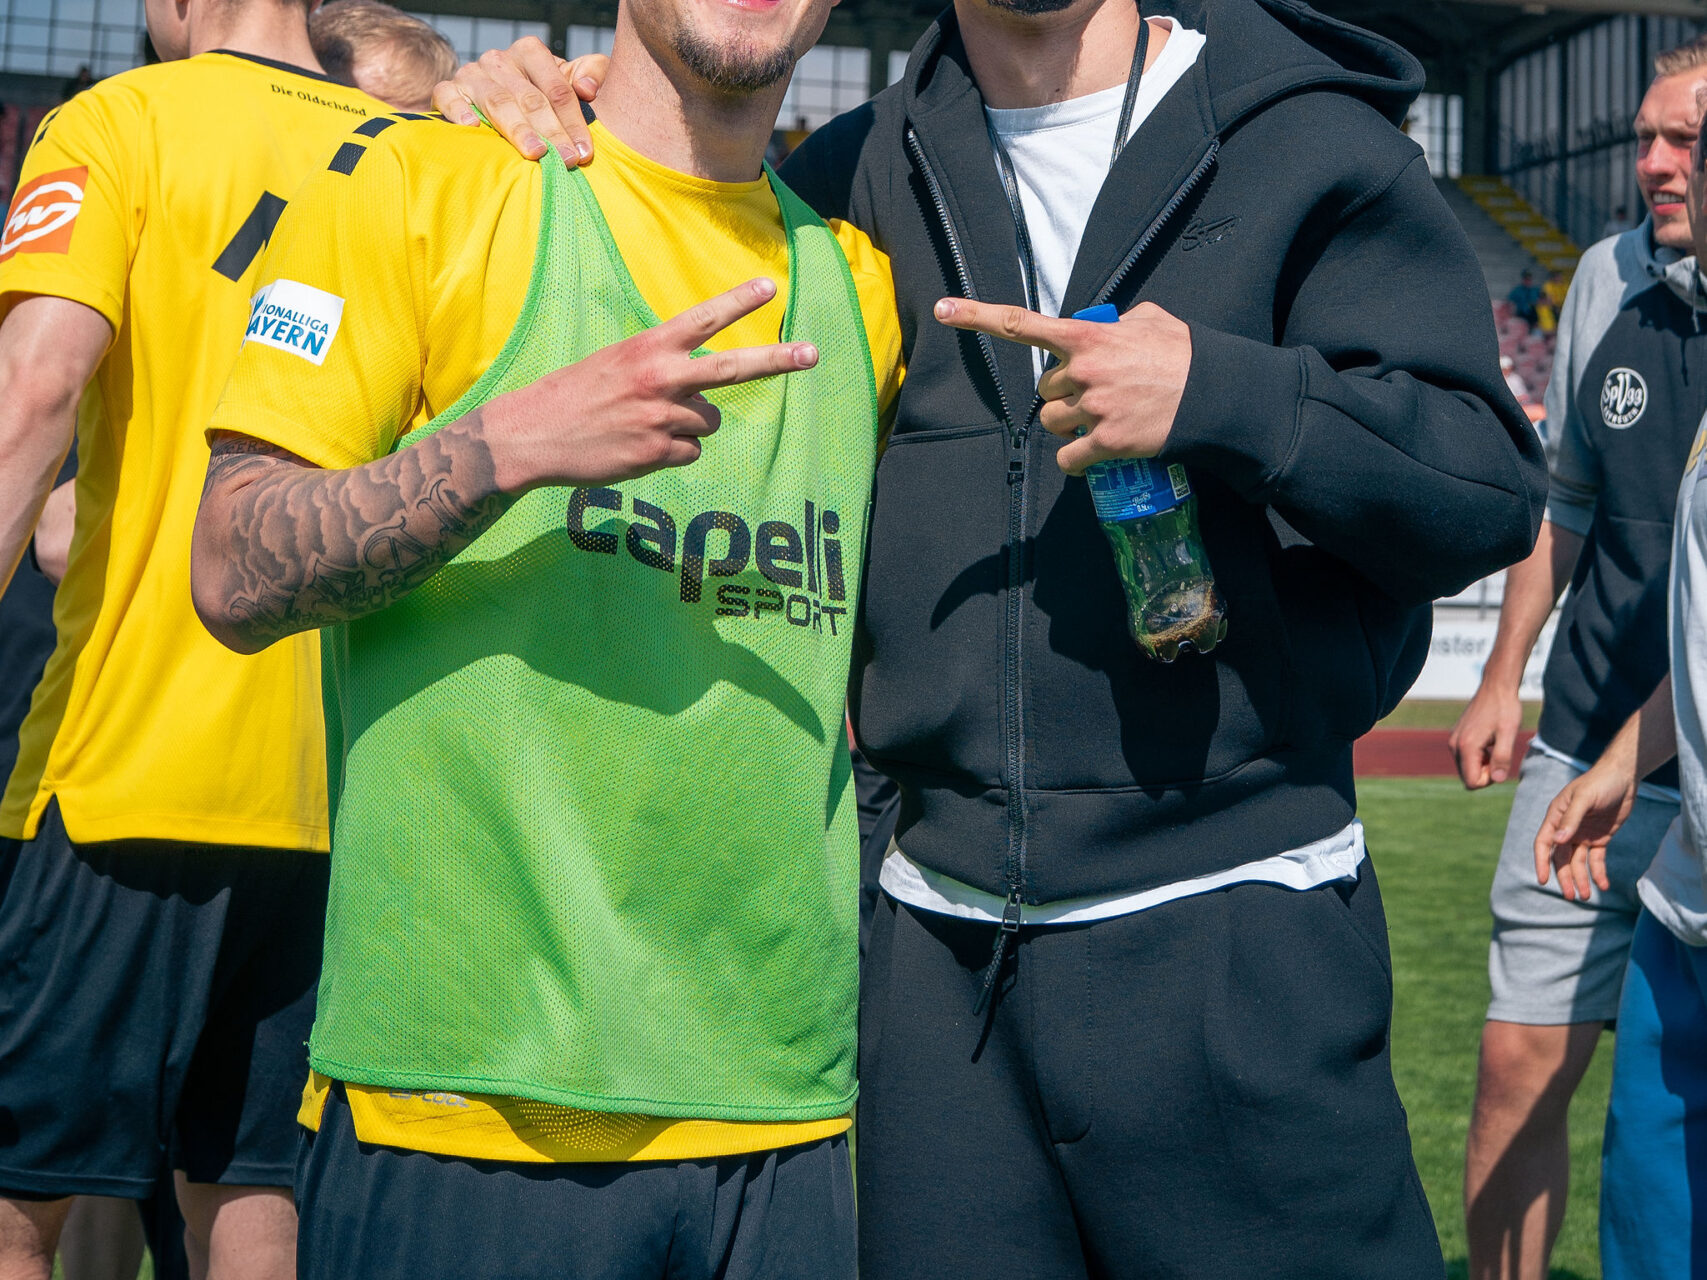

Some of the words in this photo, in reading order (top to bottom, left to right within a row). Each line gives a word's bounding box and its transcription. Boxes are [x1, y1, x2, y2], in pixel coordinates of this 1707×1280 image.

[271, 84, 293, 96] Die
[297, 91, 367, 116] Oldschdod
[245, 315, 326, 356] AYERN
[260, 303, 329, 335] IONALLIGA
[566, 486, 846, 604] capeli
[715, 583, 847, 637] SPORT
